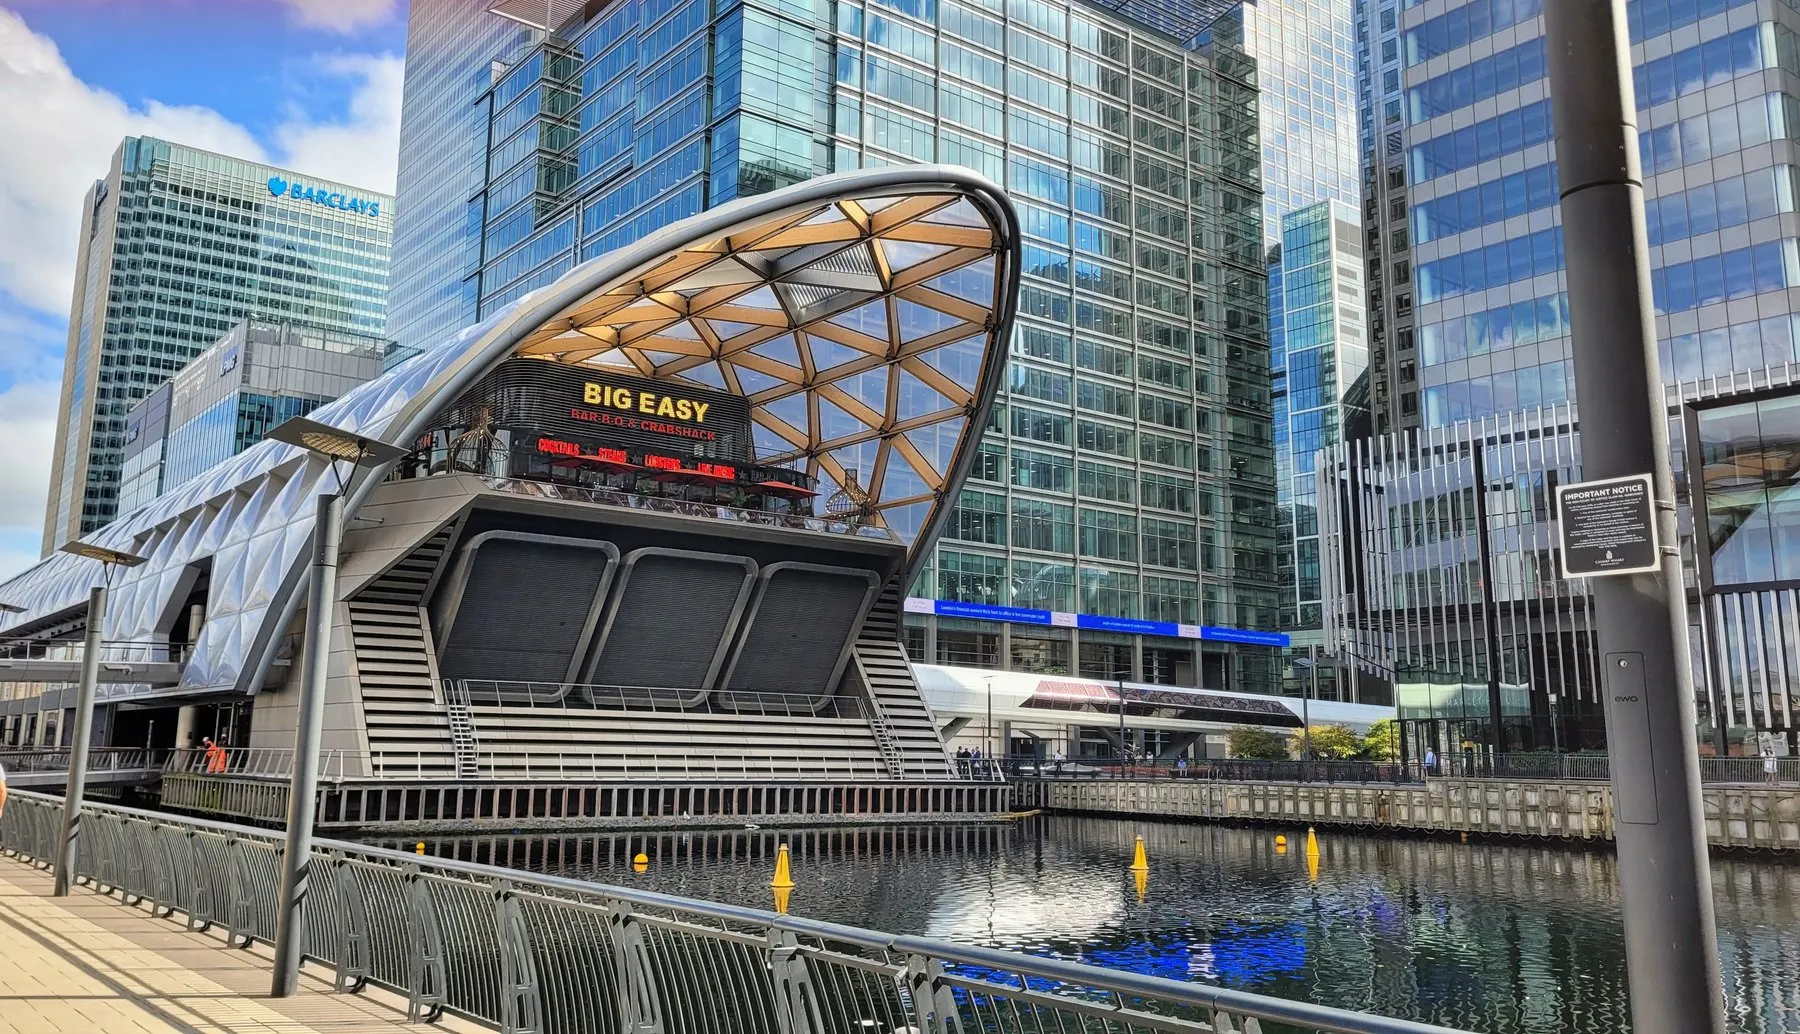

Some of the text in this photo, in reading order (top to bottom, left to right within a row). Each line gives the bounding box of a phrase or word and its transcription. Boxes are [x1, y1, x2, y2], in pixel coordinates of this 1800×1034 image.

[291, 183, 379, 217] BARCLAYS
[584, 382, 709, 423] BIG EASY
[571, 408, 716, 441] BAR-B-Q & CRABSHACK
[537, 438, 580, 456] COCKTAILS
[599, 447, 627, 463] STEAKS
[645, 455, 681, 471] LOBSTERS
[698, 463, 713, 474] LIVE
[713, 464, 735, 479] MUSIC
[1565, 484, 1643, 500] IMPORTANT NOTICE
